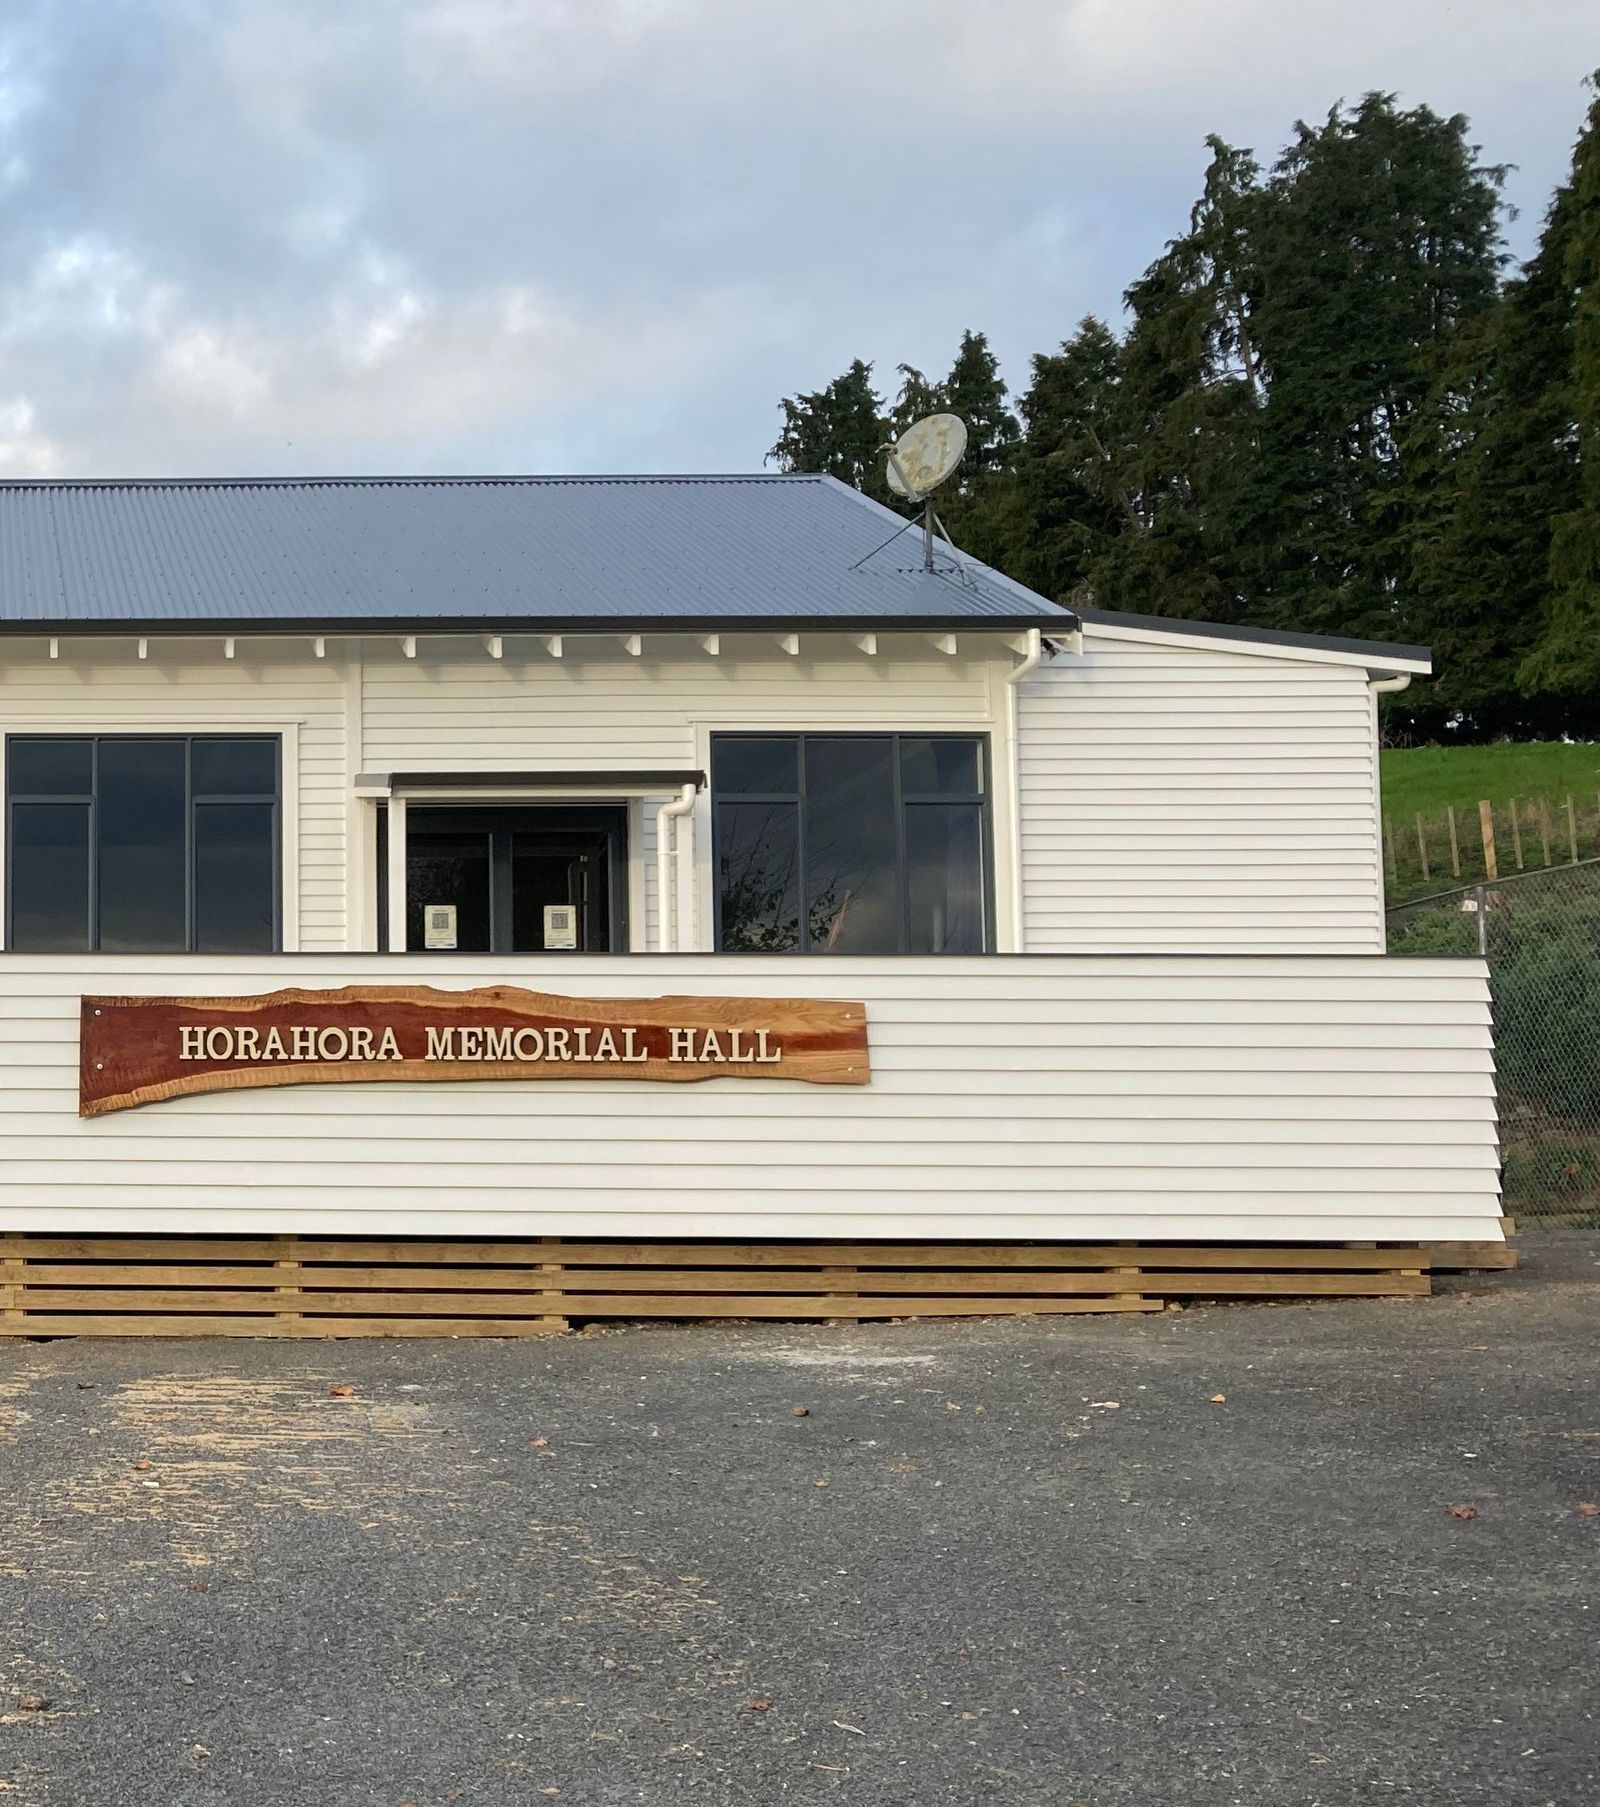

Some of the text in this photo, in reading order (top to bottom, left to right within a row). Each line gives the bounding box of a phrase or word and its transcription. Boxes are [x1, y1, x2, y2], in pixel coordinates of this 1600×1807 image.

[179, 1026, 781, 1062] HORAHORA MEMORIAL HALL
